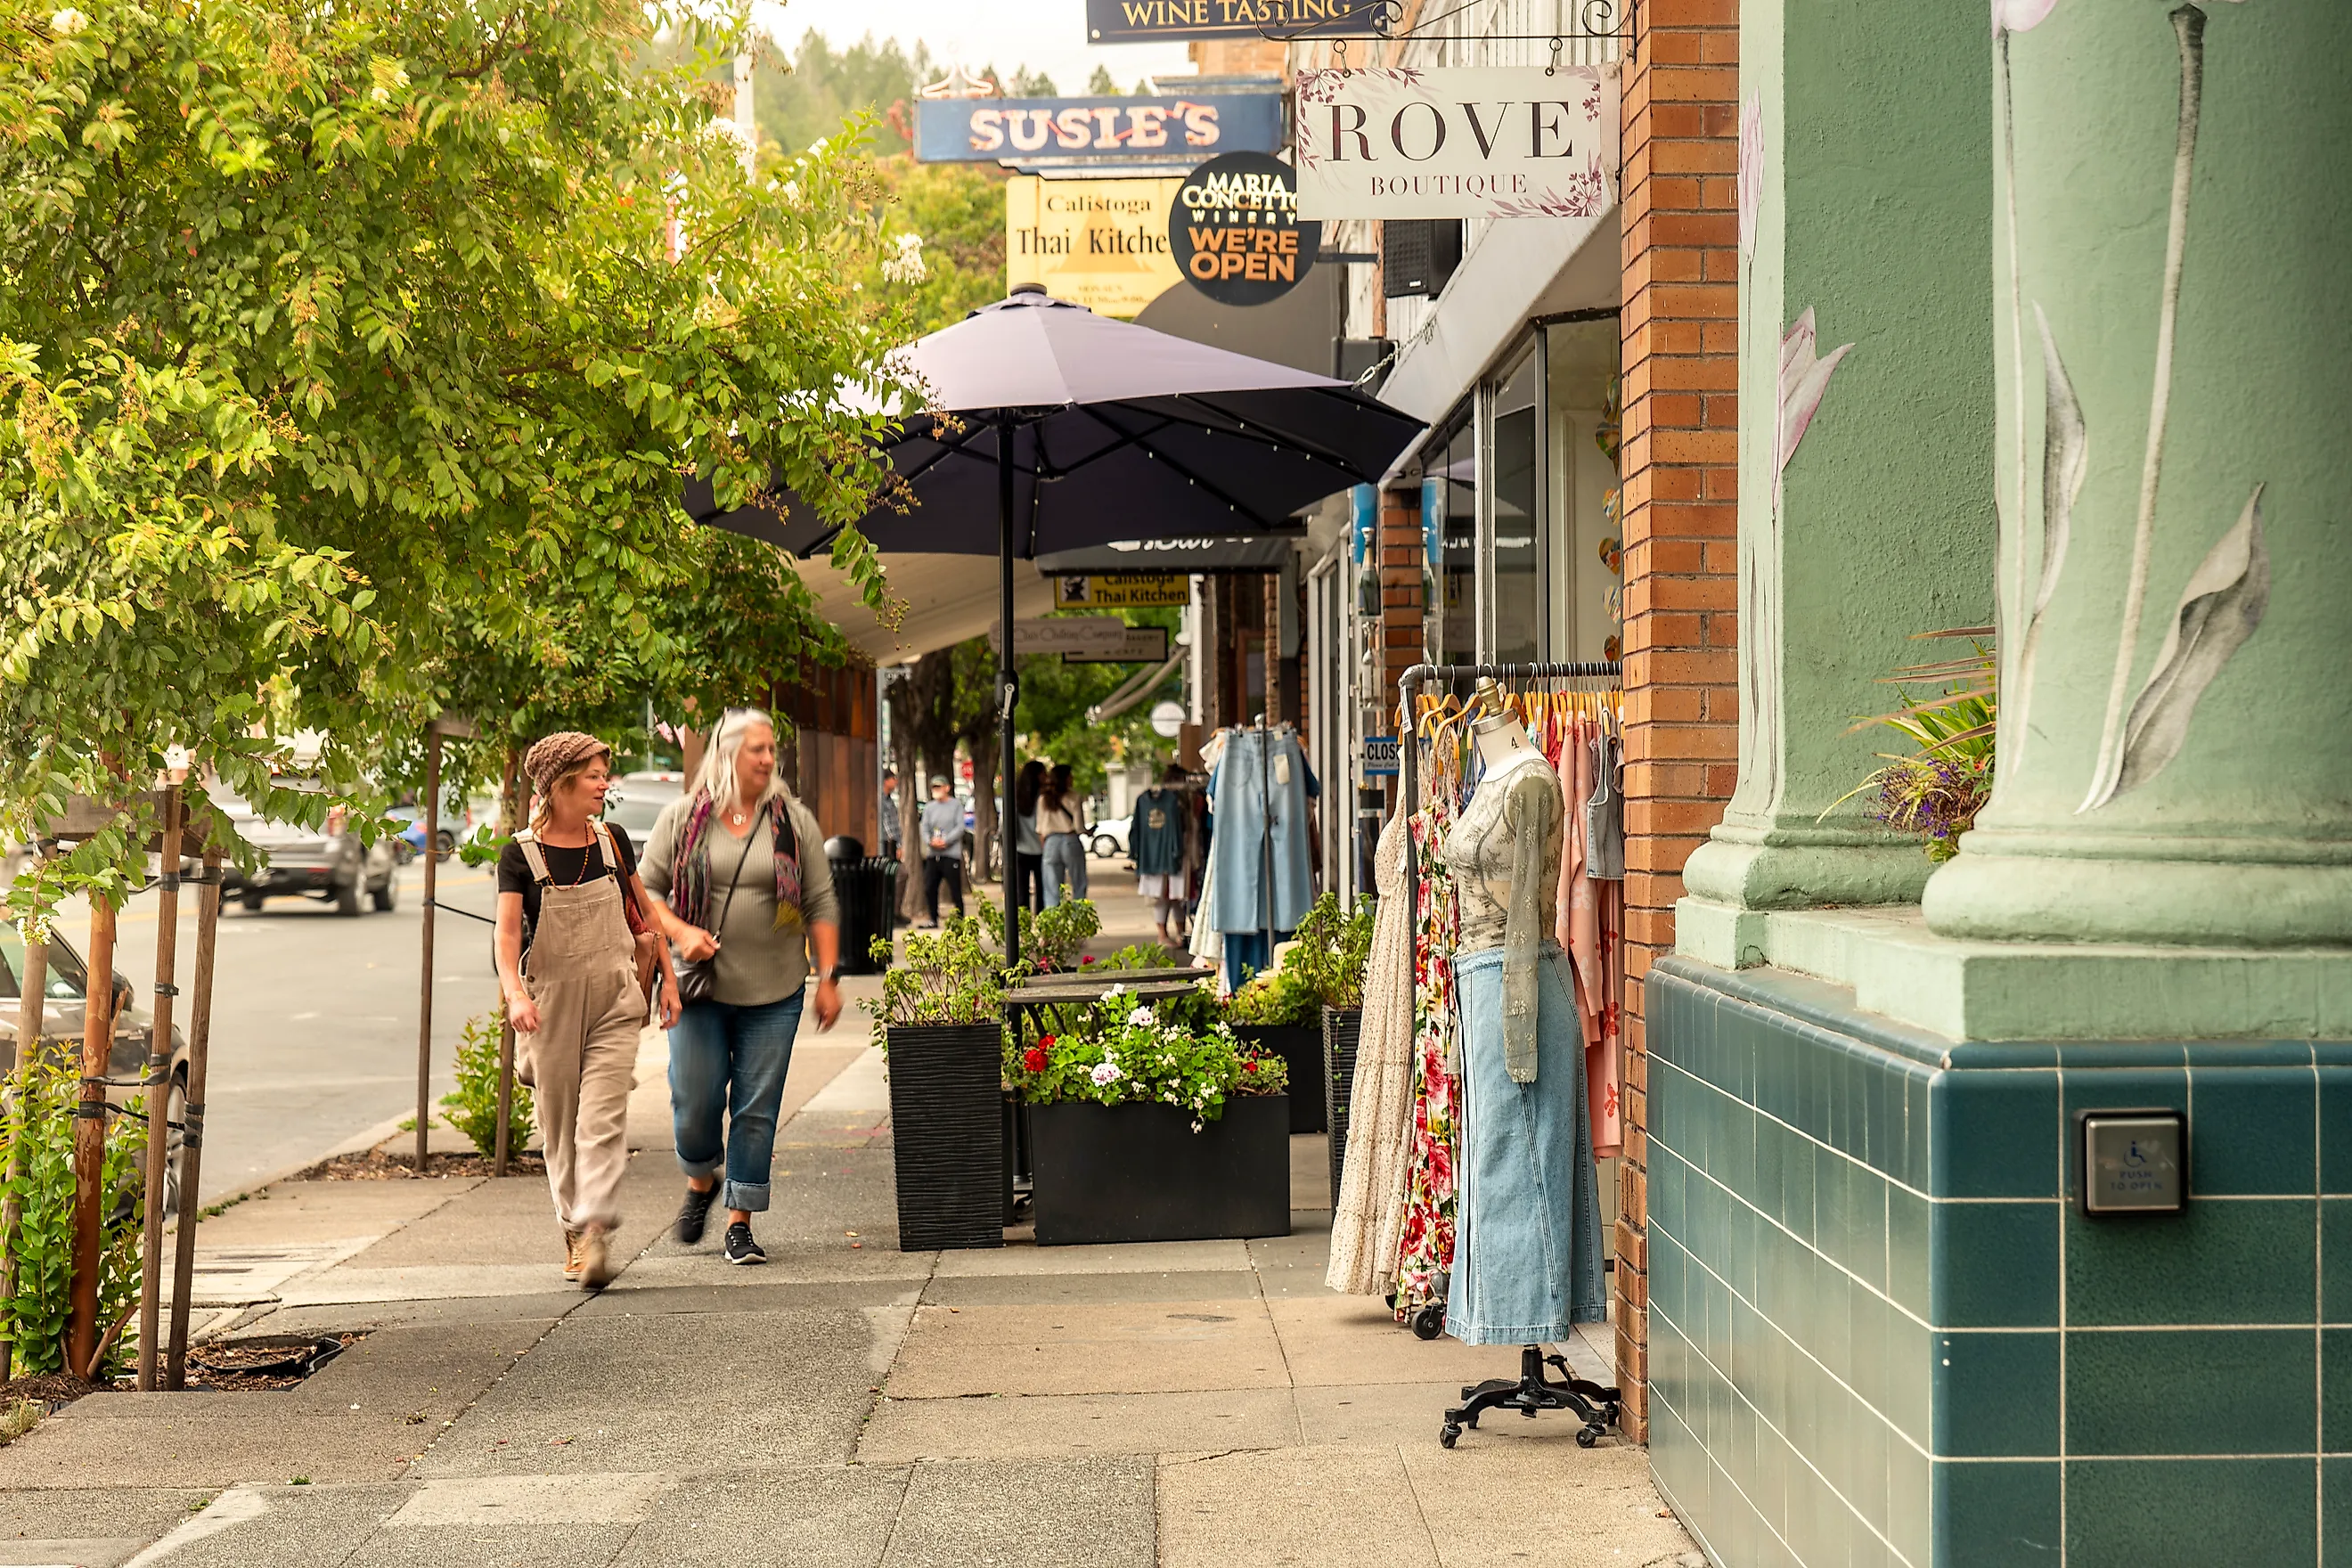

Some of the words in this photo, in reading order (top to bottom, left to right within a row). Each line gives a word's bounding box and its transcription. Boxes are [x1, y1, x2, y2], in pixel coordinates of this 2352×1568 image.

[1123, 0, 1209, 27] WINE
[1222, 0, 1352, 24] TASTING
[969, 101, 1221, 151] SUSIE'S
[1323, 101, 1573, 162] ROVE
[1206, 171, 1286, 197] MARIA
[1370, 174, 1528, 198] BOUTIQUE
[1047, 195, 1151, 215] Calistoga
[1192, 209, 1297, 225] WINERY
[1017, 226, 1070, 255] Thai
[1090, 225, 1172, 255] Kitche
[1188, 226, 1299, 255] WE'RE
[1189, 250, 1295, 282] OPEN
[1104, 575, 1174, 588] Calistoga
[1094, 589, 1127, 603] Thai
[1130, 588, 1186, 602] Kitchen
[1511, 736, 1520, 749] 4
[2111, 1181, 2126, 1190] TO
[2119, 1171, 2153, 1179] PUSH
